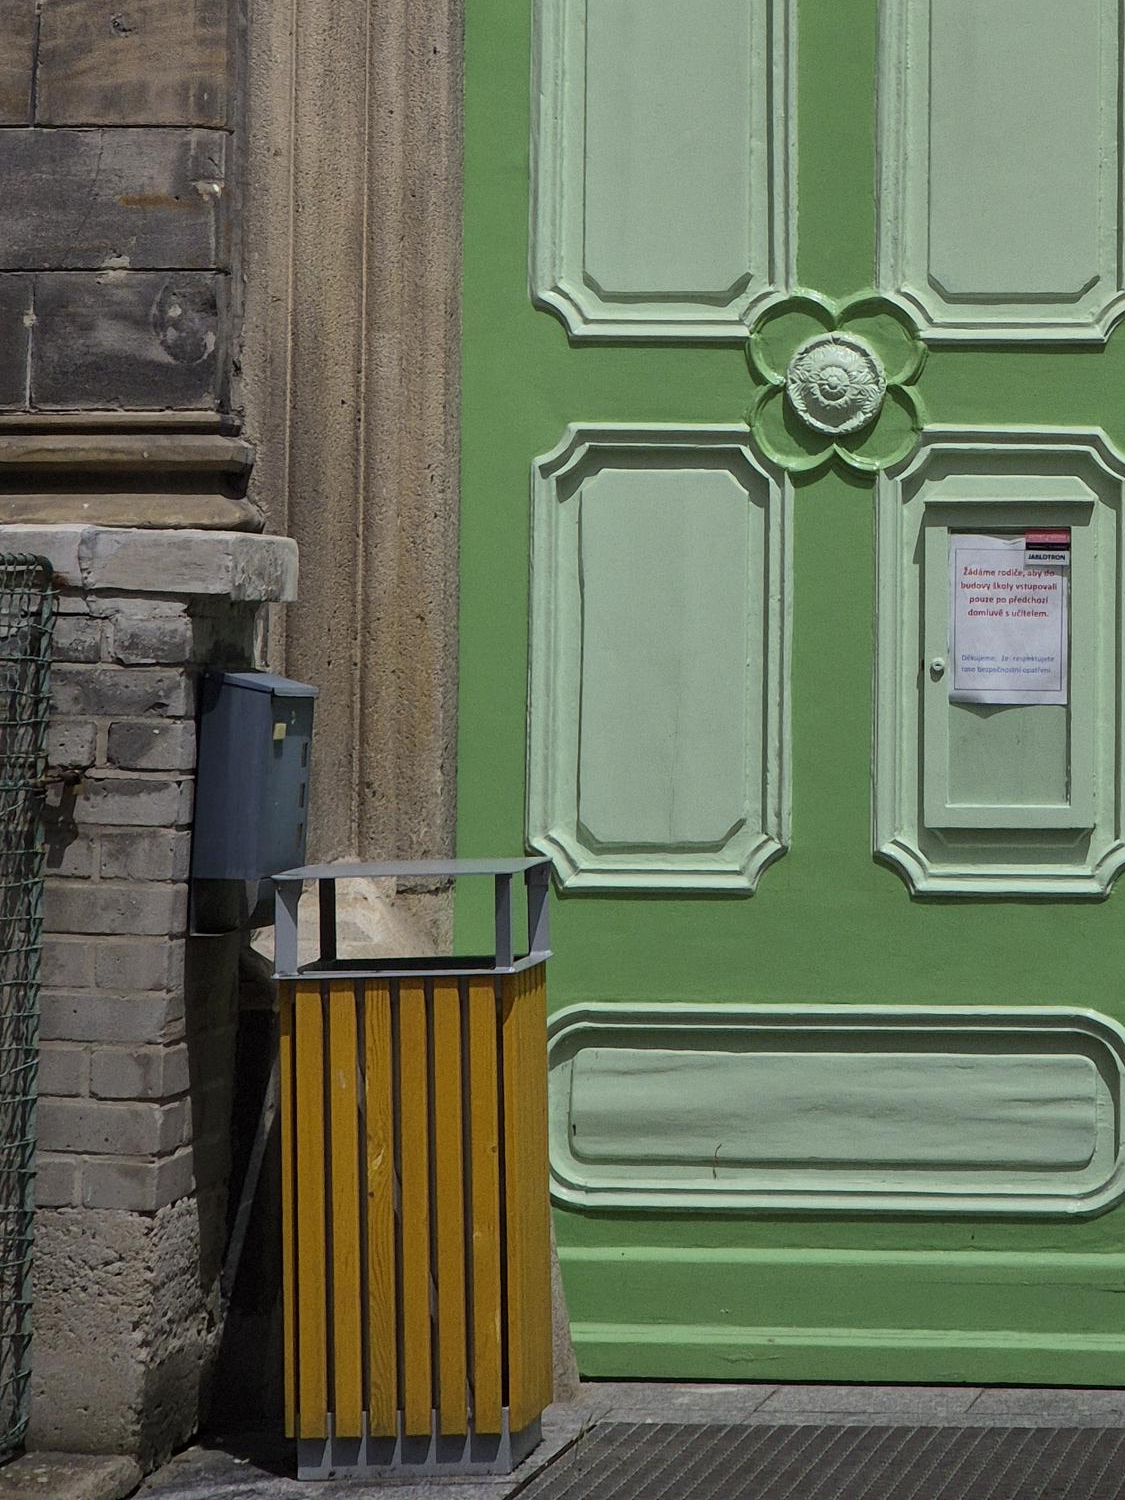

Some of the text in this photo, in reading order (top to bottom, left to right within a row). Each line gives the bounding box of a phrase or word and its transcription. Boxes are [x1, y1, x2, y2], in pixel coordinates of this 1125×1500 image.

[963, 567, 995, 576] Žádáme
[998, 568, 1025, 577] rodiče,
[1027, 568, 1042, 578] aby
[961, 582, 1057, 591] budovy školy vstupovali
[969, 596, 994, 604] pouze
[1008, 596, 1048, 604] předchozí
[968, 609, 1003, 617] domluvě
[1012, 609, 1049, 617] učitelem.
